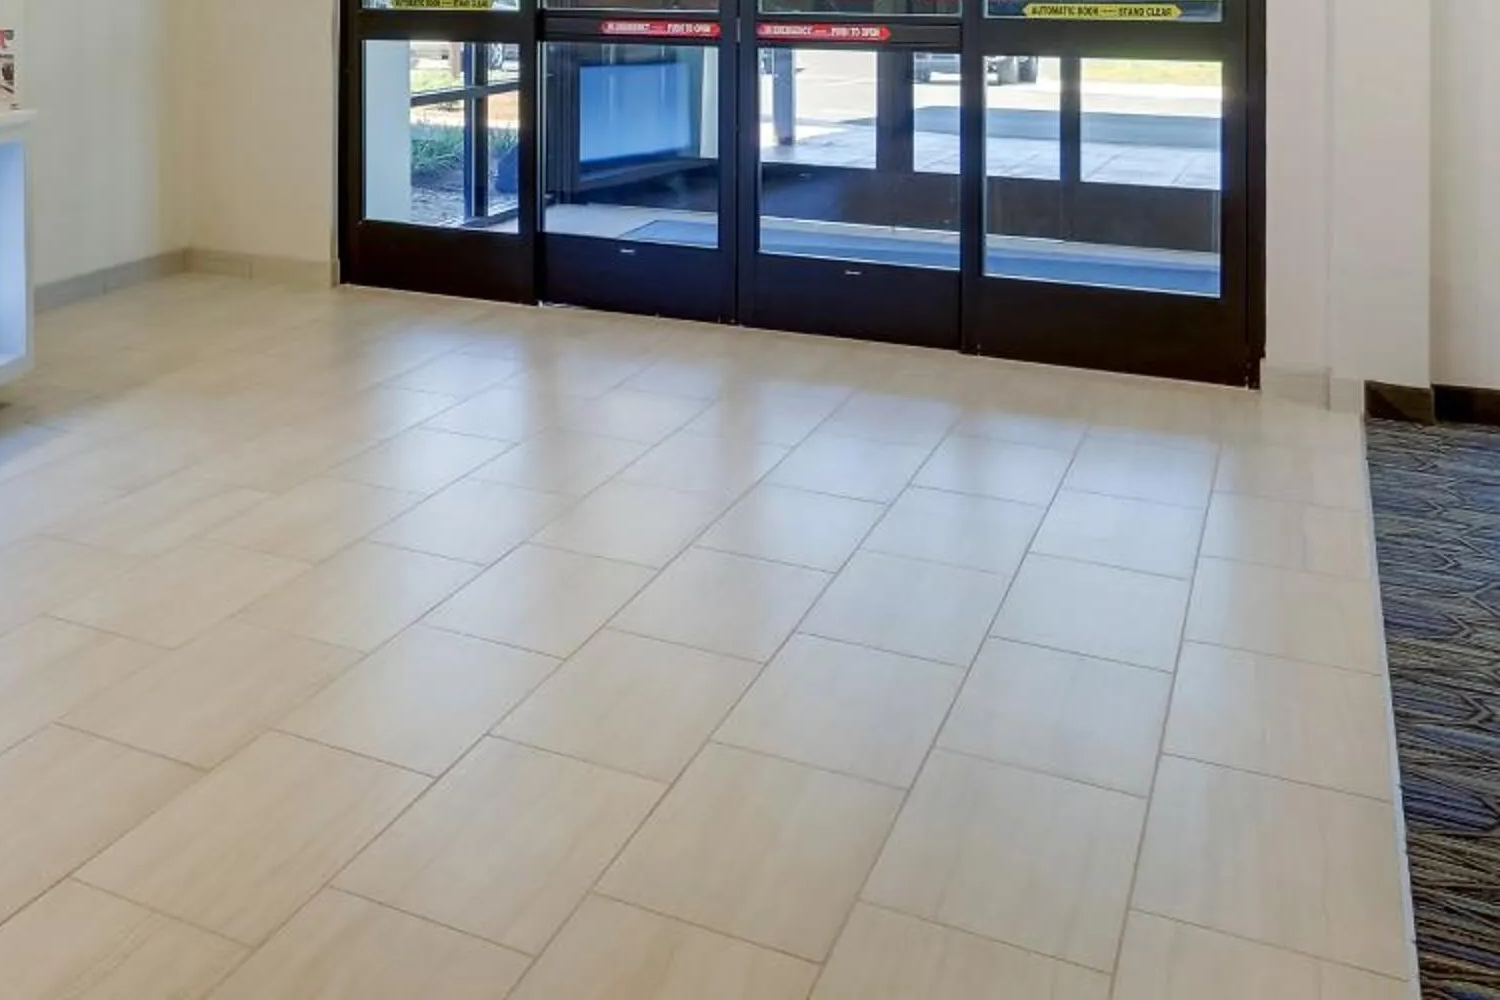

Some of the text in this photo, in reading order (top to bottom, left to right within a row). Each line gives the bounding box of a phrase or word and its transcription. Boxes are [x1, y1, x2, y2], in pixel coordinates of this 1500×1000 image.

[1031, 6, 1075, 16] AUTOMATIC
[1118, 7, 1144, 17] STAND
[1146, 7, 1173, 17] CLEAR
